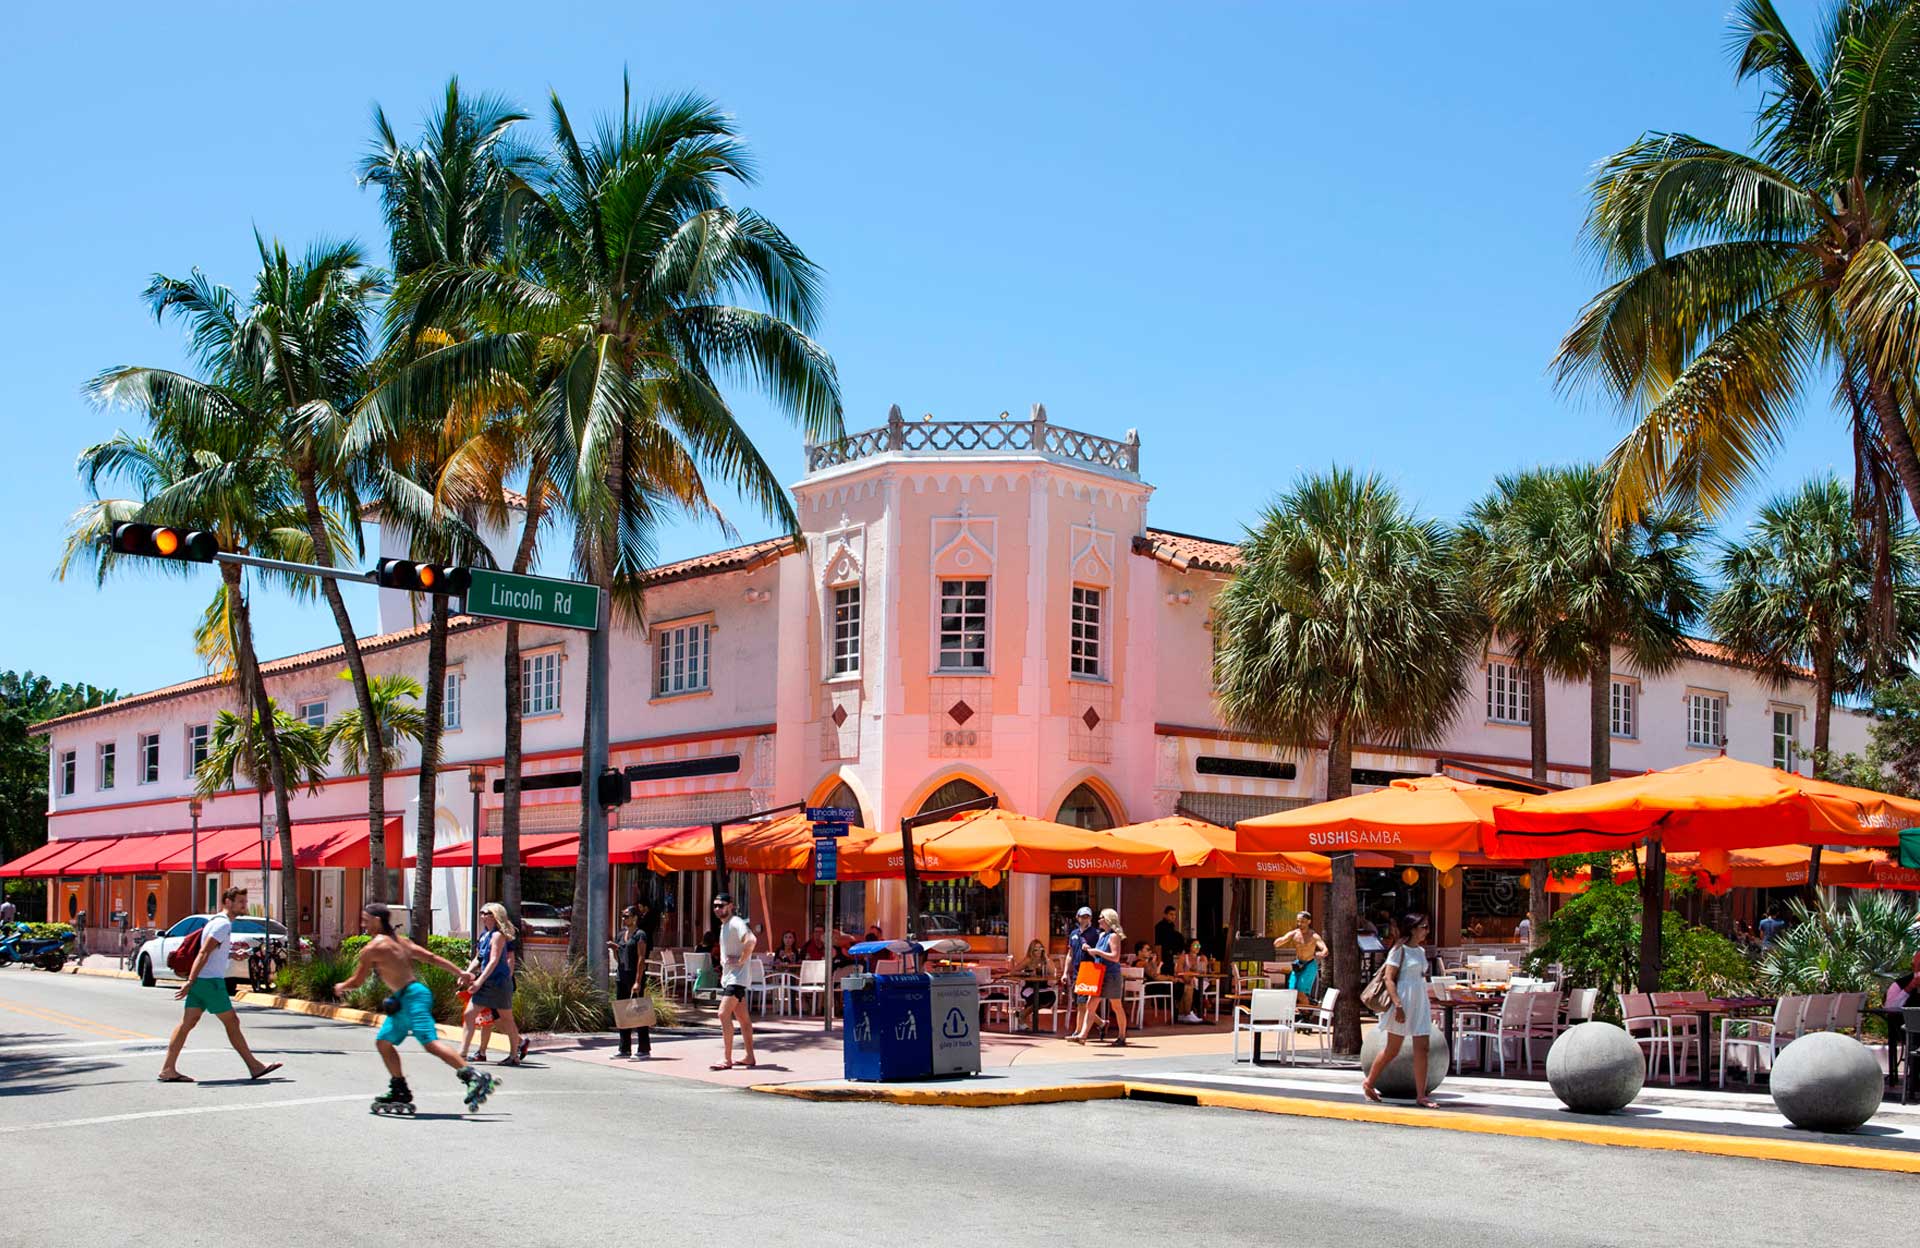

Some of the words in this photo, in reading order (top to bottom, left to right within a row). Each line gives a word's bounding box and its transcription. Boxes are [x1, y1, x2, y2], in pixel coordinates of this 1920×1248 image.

[491, 583, 543, 611] Lincoln
[553, 591, 572, 615] Rd
[812, 808, 837, 816] Lincoln
[838, 808, 855, 817] Road
[1308, 830, 1402, 845] SUSHISAMBA
[1067, 858, 1129, 870] SUSHISAMBA
